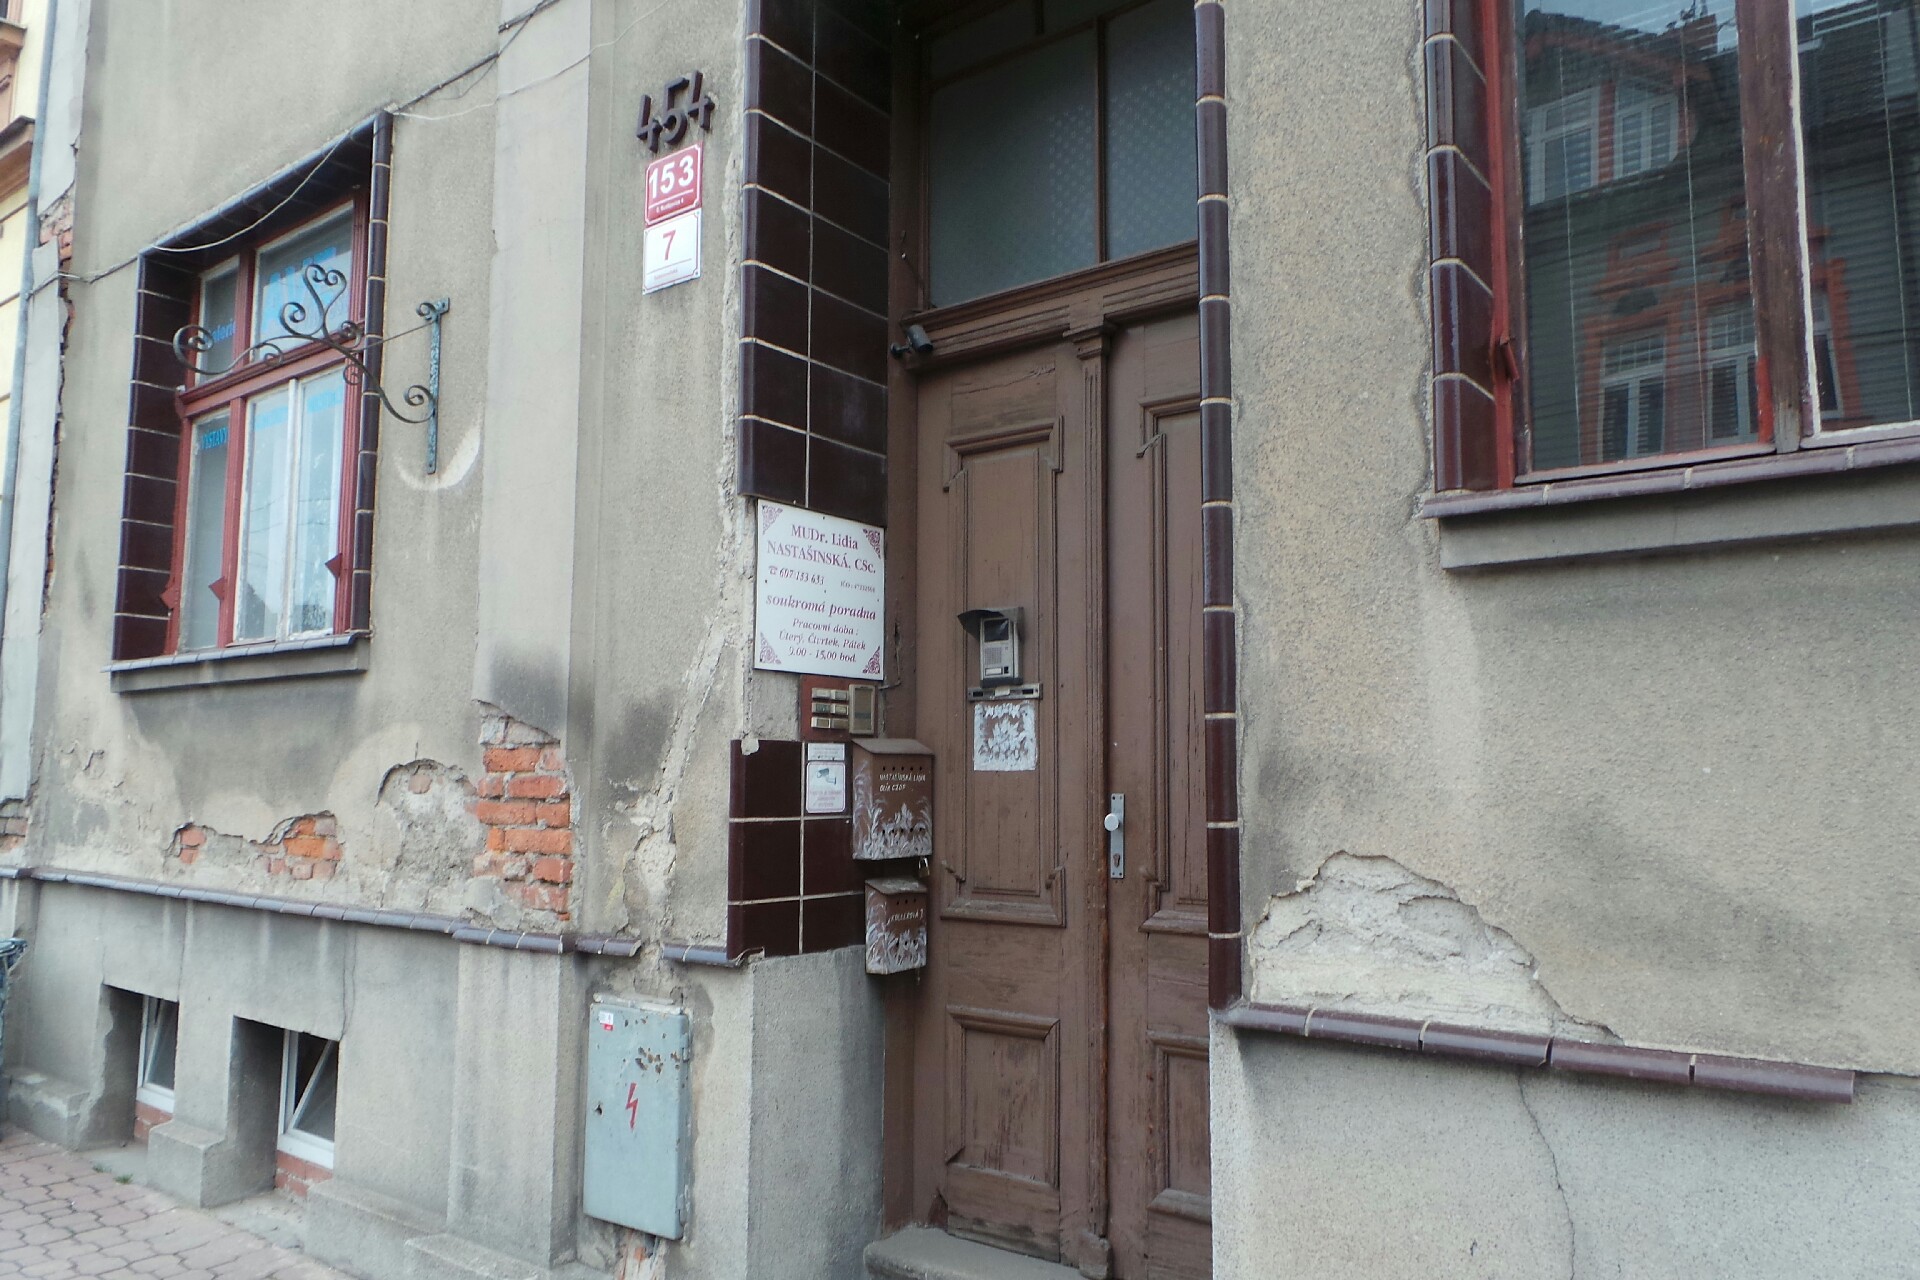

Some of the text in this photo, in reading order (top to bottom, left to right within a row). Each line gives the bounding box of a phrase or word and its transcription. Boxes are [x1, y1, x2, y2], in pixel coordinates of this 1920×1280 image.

[636, 69, 716, 153] 454
[648, 154, 695, 199] 153
[662, 230, 677, 262] 7
[791, 524, 858, 550] MUDr. Lidia
[854, 558, 876, 574] CSc.
[765, 594, 876, 621] soukromá poradna
[792, 618, 831, 631] Pracovní
[842, 639, 866, 651] Pátek
